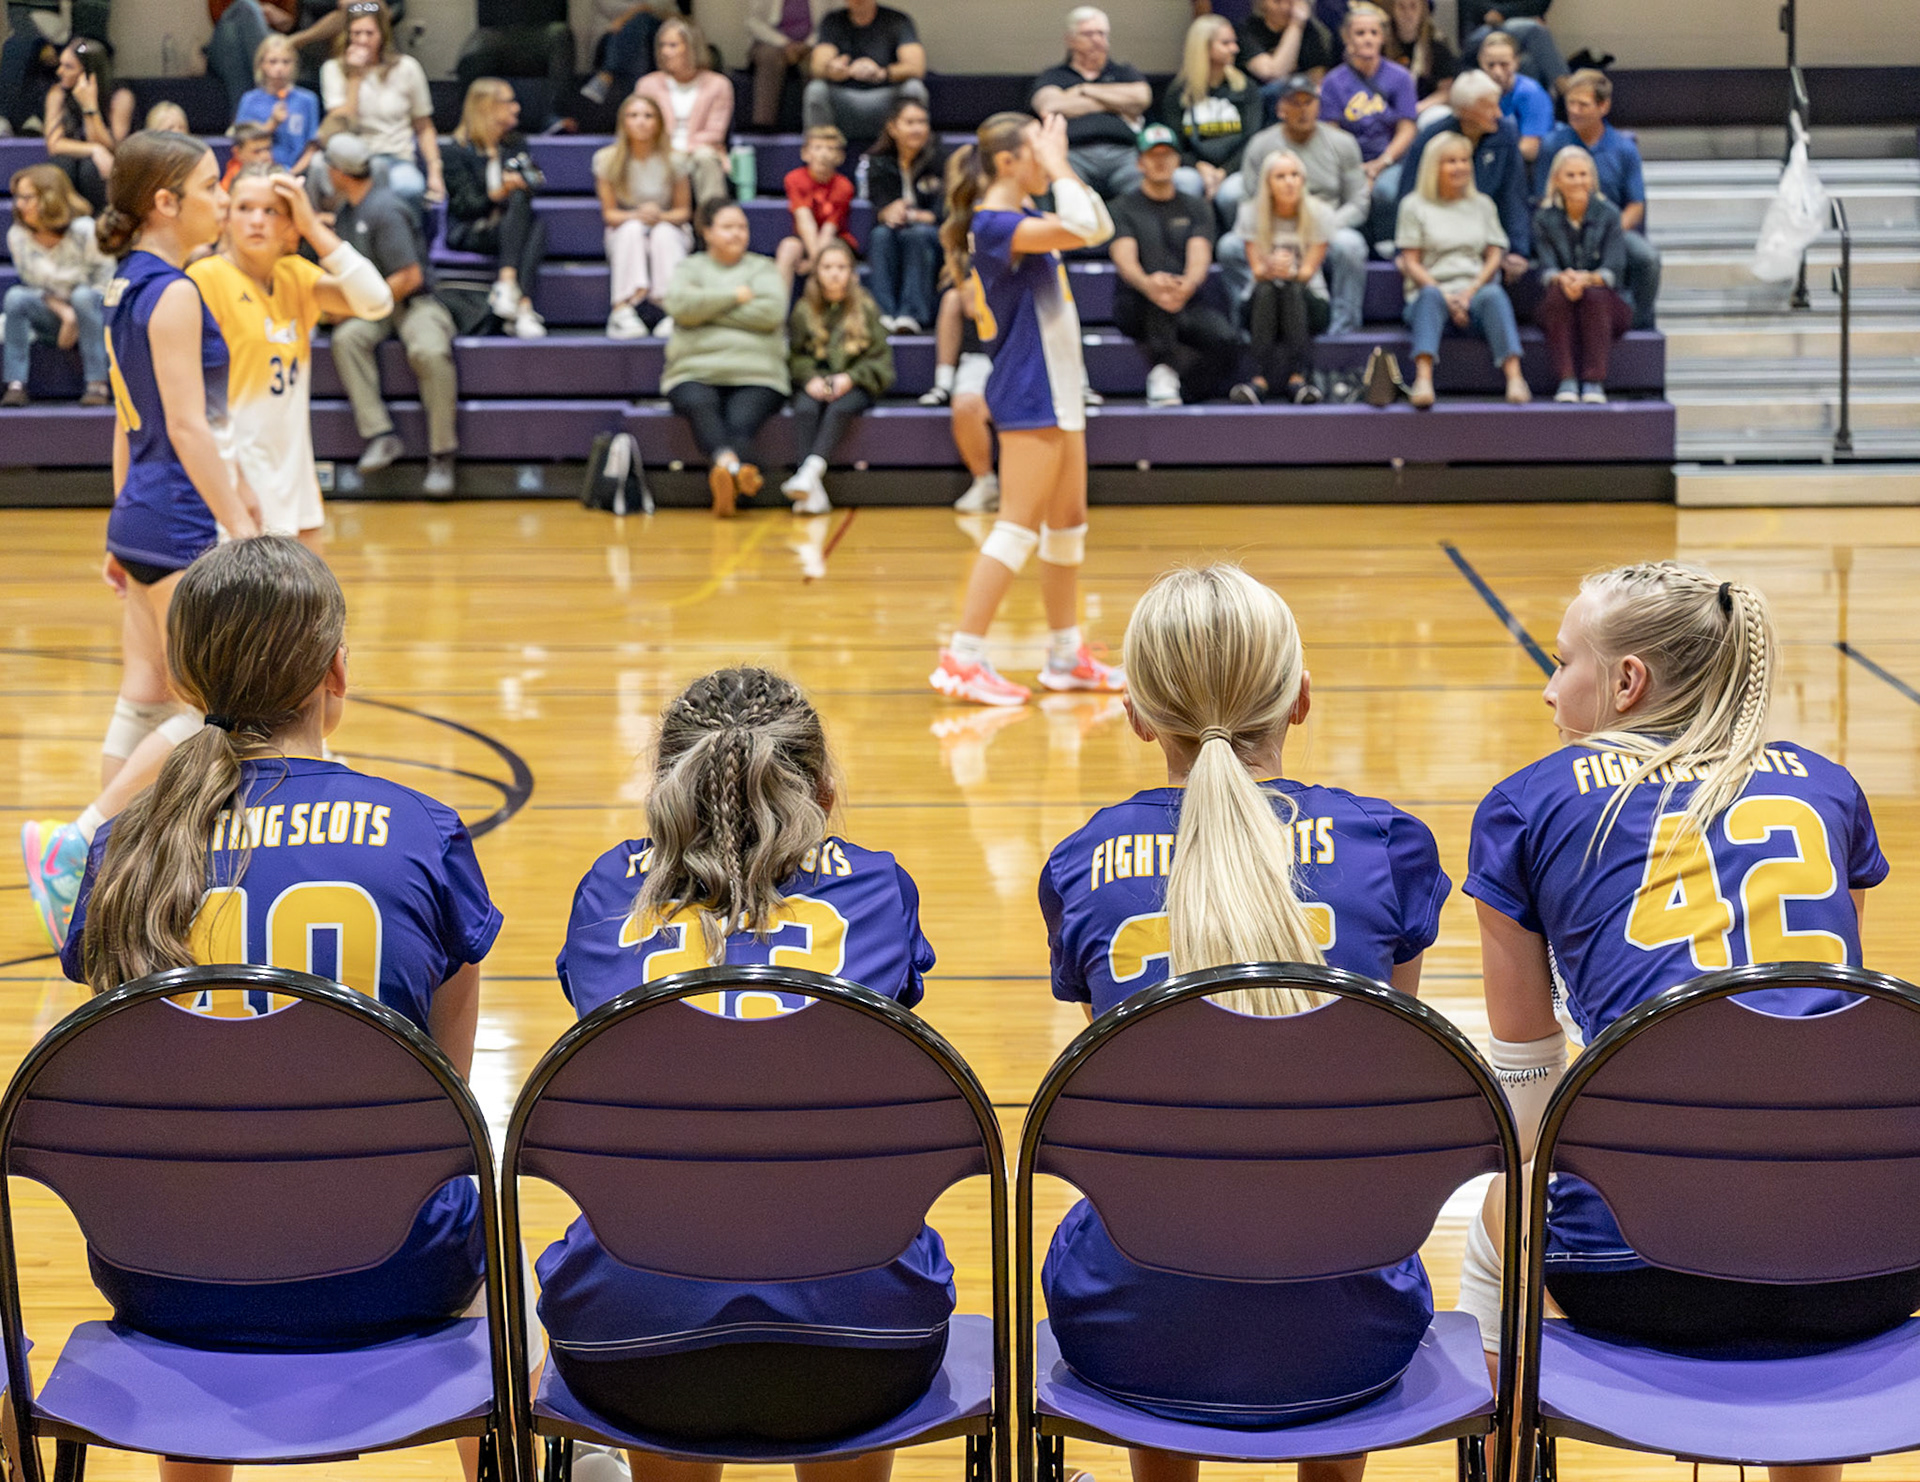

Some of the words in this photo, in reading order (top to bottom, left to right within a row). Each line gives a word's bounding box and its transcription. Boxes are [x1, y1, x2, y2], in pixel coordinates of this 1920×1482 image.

[269, 355, 299, 396] 34
[1751, 749, 1809, 778] OTS
[211, 804, 285, 853] TING
[288, 801, 391, 847] SCOTS
[800, 840, 852, 877] OTS
[1090, 833, 1176, 891] FIGHT
[1624, 795, 1848, 972] 42
